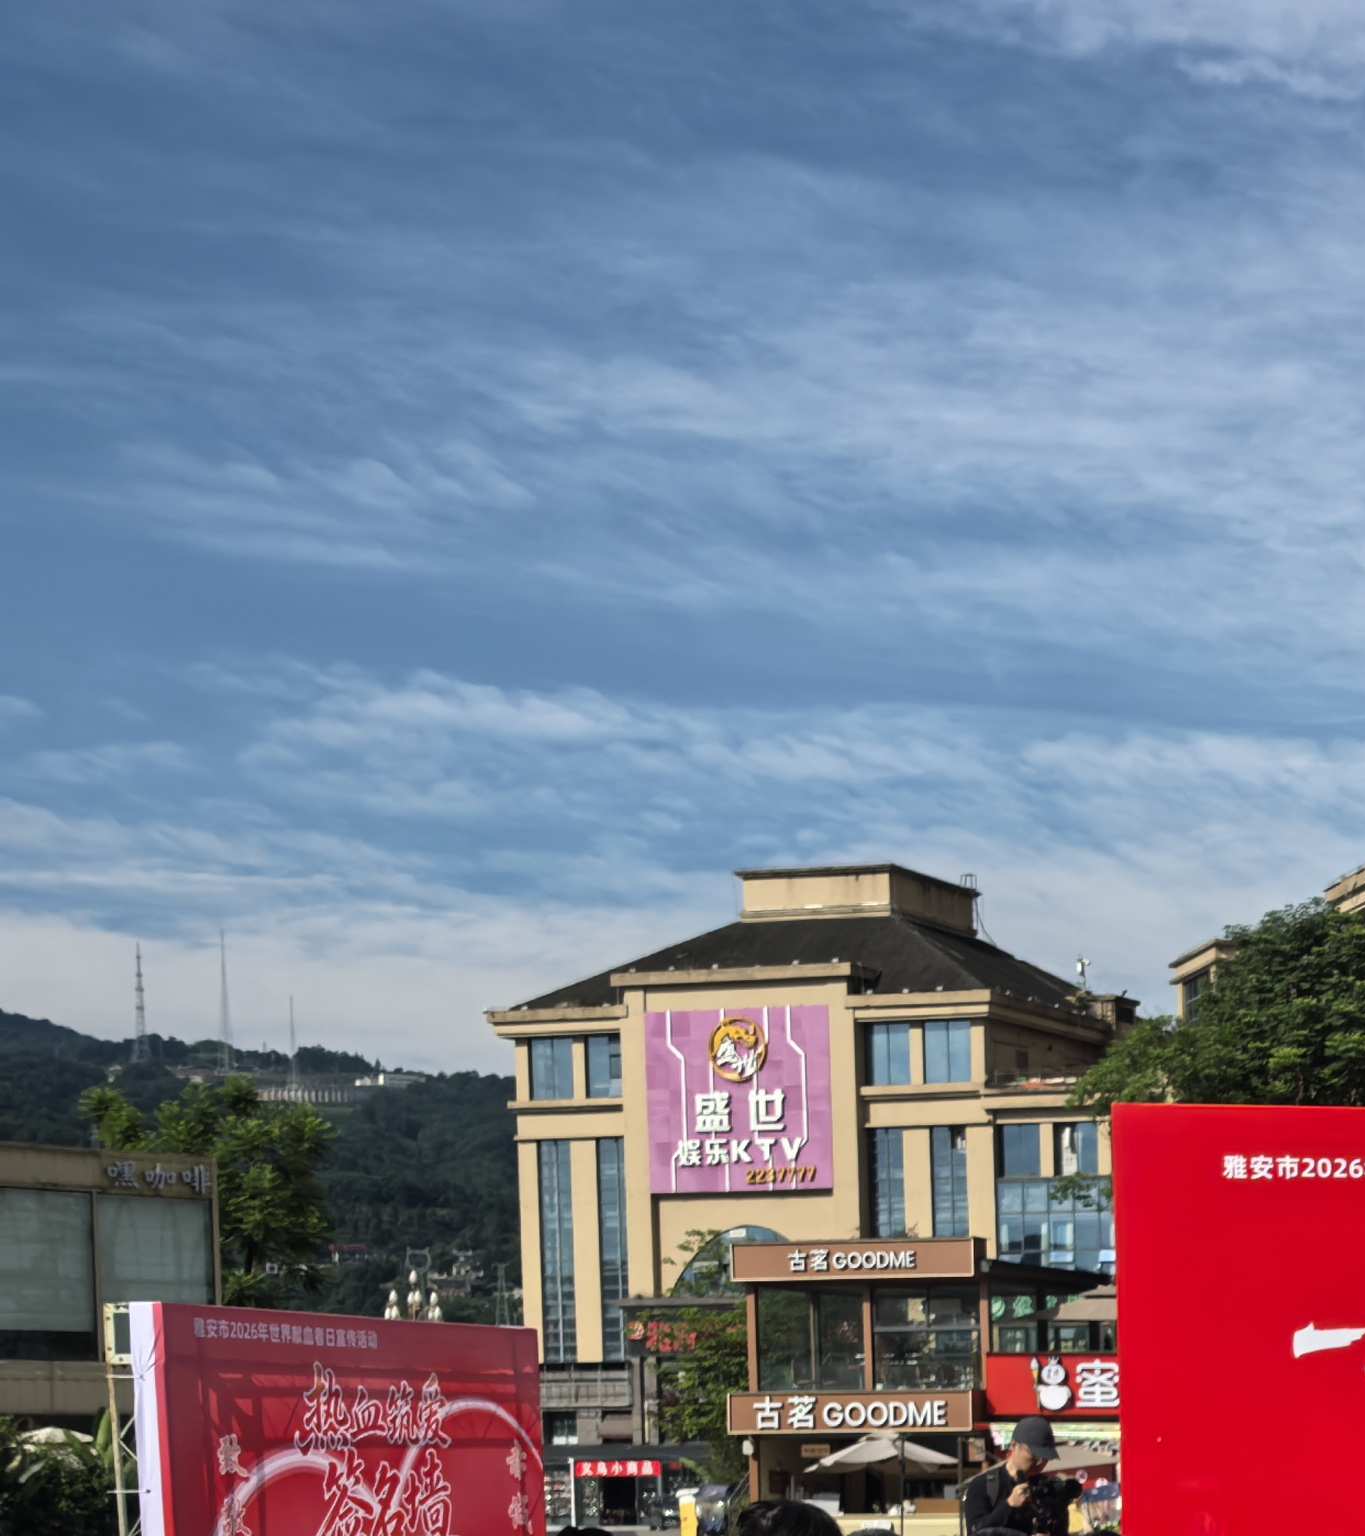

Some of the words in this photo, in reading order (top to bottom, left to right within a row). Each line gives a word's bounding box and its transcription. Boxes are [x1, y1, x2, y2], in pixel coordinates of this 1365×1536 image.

[695, 1088, 786, 1133] 盛世
[677, 1136, 802, 1168] 娱乐KTV
[788, 1248, 829, 1273] 古茗
[832, 1250, 916, 1271] GOODME
[753, 1396, 817, 1430] 古茗
[822, 1401, 946, 1428] GOODME
[580, 1460, 654, 1476] 义乌小商品
